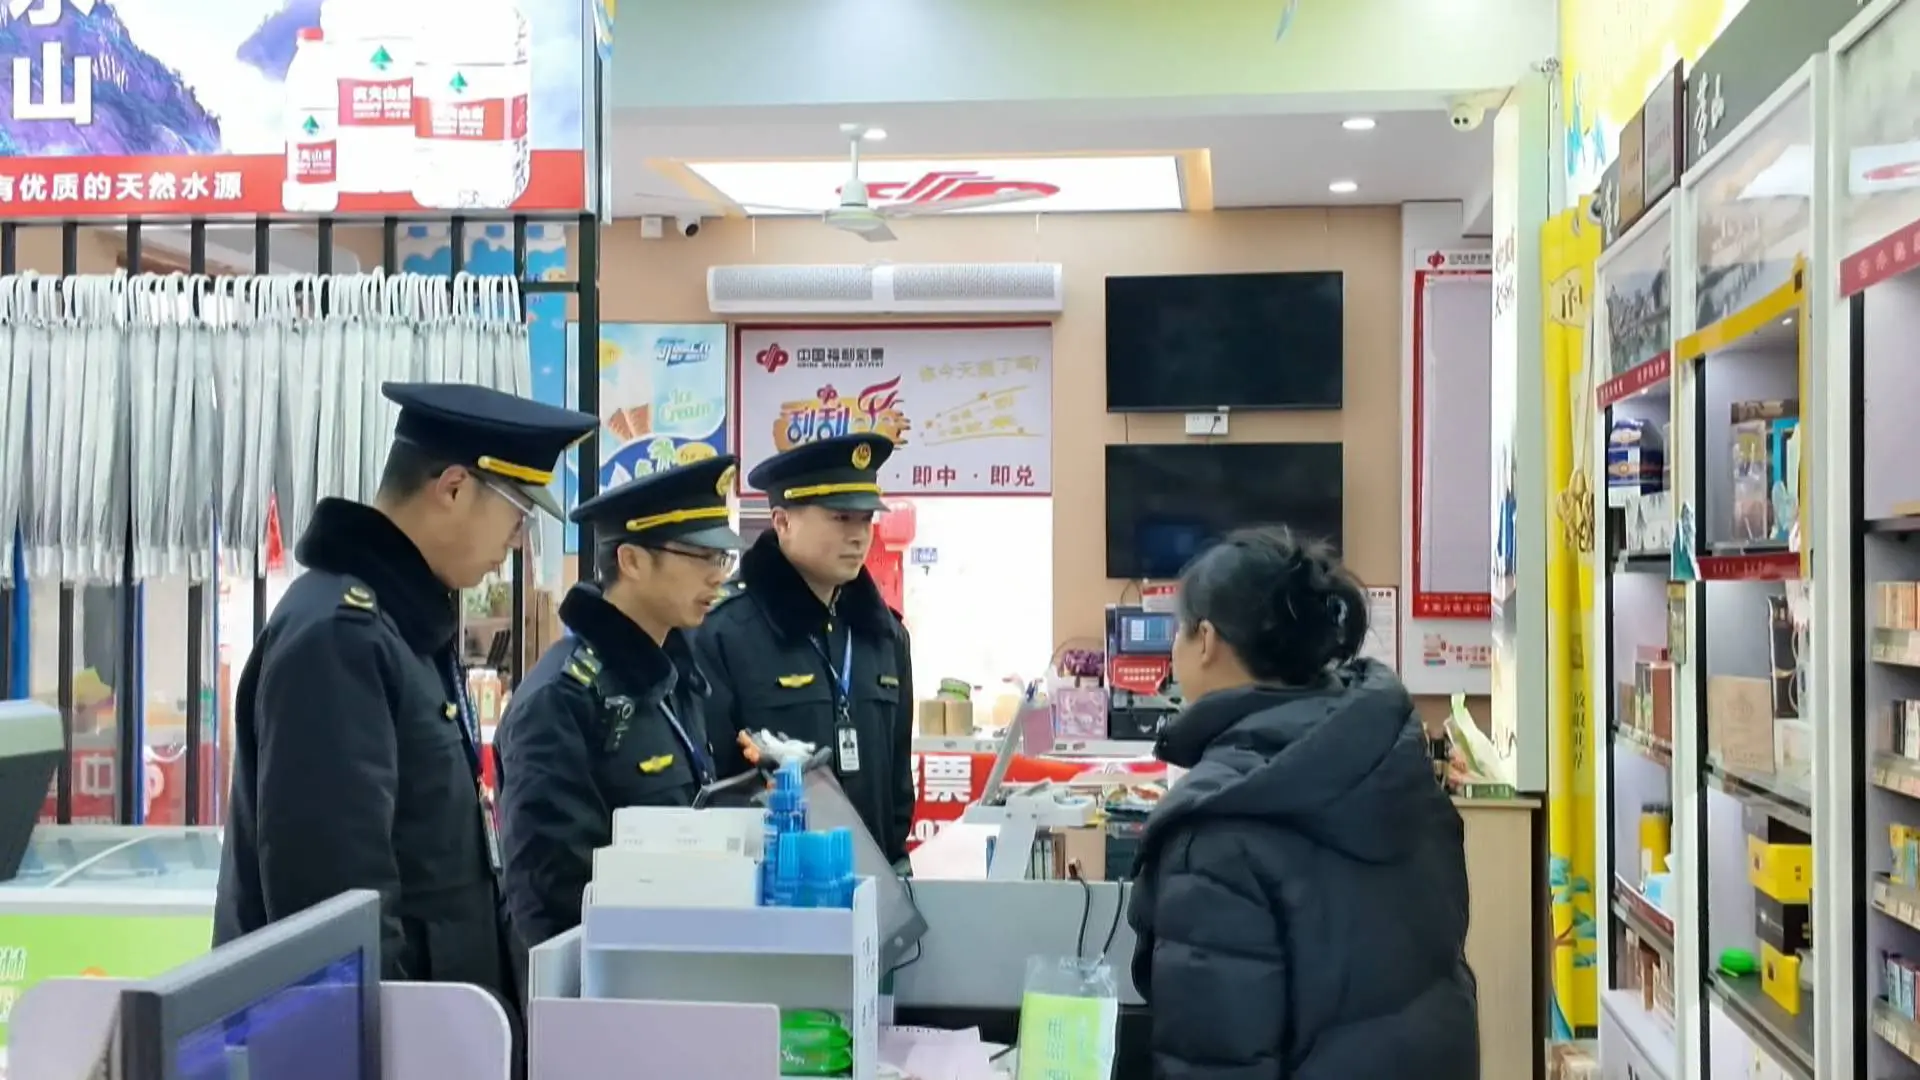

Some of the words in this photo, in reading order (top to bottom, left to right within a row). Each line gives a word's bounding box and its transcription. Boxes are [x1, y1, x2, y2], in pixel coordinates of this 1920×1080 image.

[12, 41, 92, 125] 山
[796, 347, 884, 361] 中国福利彩票
[912, 464, 956, 487] 即中
[990, 464, 1035, 487] 即兑
[911, 754, 971, 803] 票
